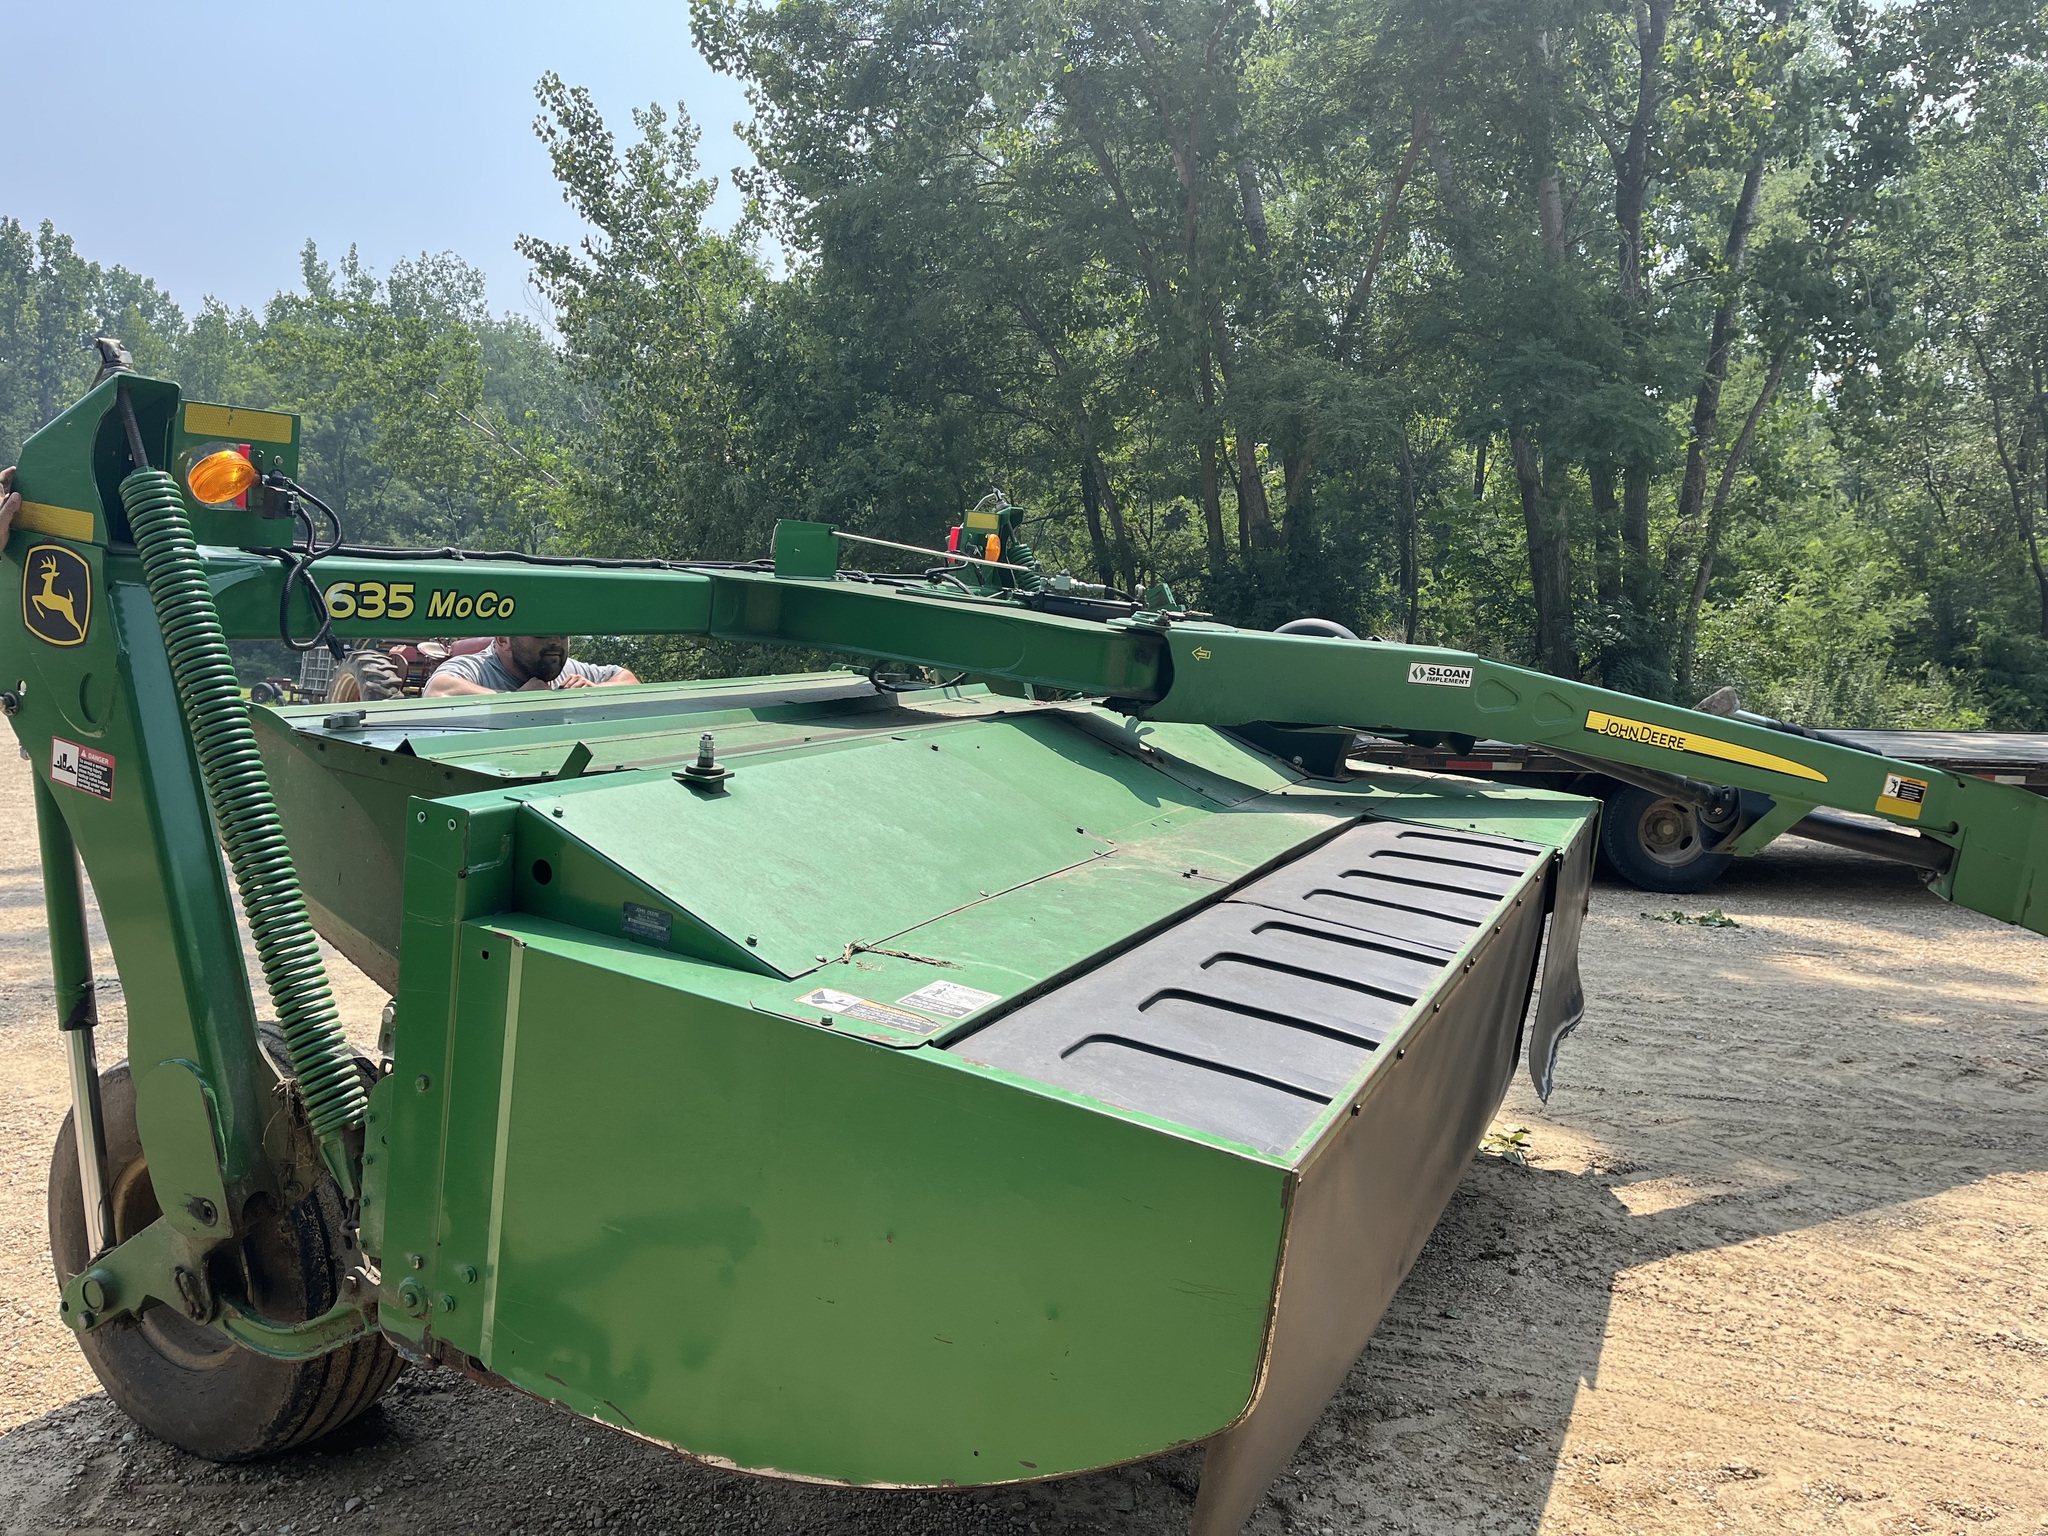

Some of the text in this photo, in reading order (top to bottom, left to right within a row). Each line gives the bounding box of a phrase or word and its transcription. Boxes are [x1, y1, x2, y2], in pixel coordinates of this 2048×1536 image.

[324, 582, 515, 618] 635 MoCo
[1427, 667, 1470, 679] SLOAN
[1426, 676, 1469, 685] IMPLEMENT
[1600, 719, 1686, 749] JOHN DEERE
[88, 752, 109, 765] DANGER
